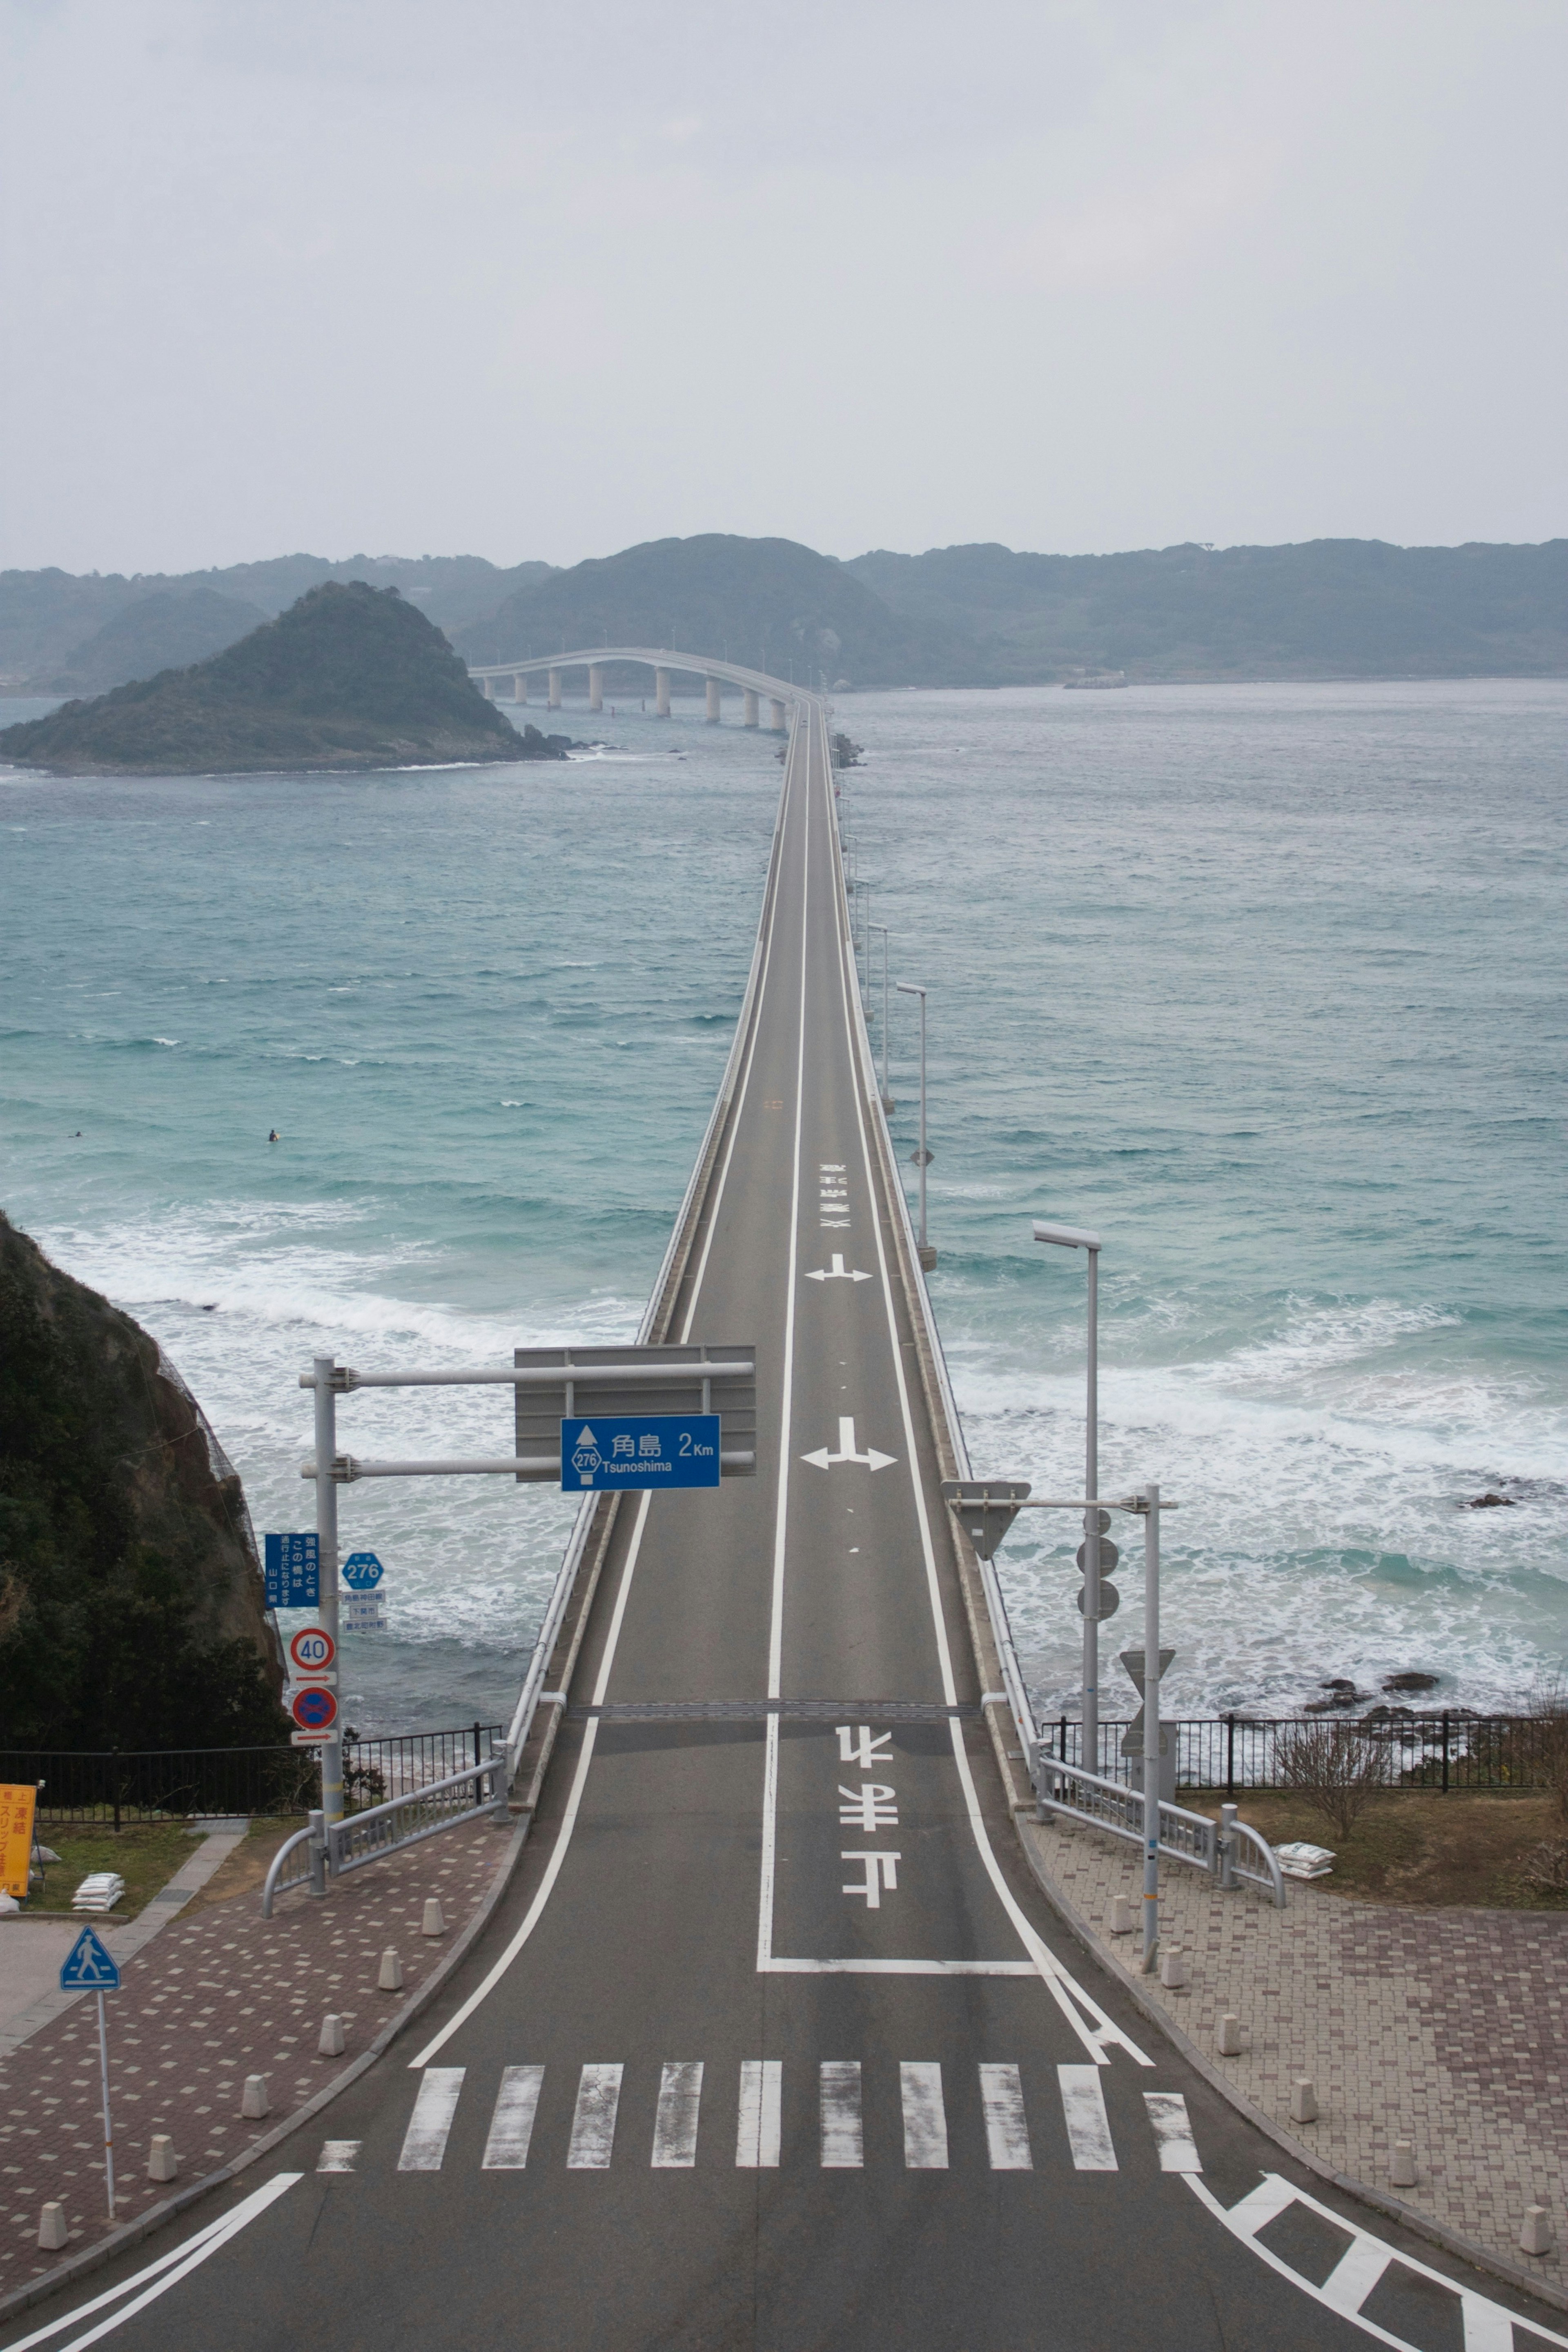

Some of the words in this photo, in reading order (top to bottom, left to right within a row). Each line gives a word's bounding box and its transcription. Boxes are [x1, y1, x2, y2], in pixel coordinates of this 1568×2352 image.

[612, 1434, 662, 1457] 角島
[577, 1454, 597, 1467] 276
[602, 1460, 672, 1473] Tsunoshima
[281, 1536, 290, 1606] 通行止になります
[292, 1541, 303, 1588] この橋は
[305, 1537, 316, 1597] 強風のとき
[347, 1564, 379, 1579] 276
[269, 1568, 277, 1603] 山口県
[301, 1640, 325, 1659] 40
[13, 1807, 28, 1835] 凍結
[835, 1726, 901, 1908] 止まれ
